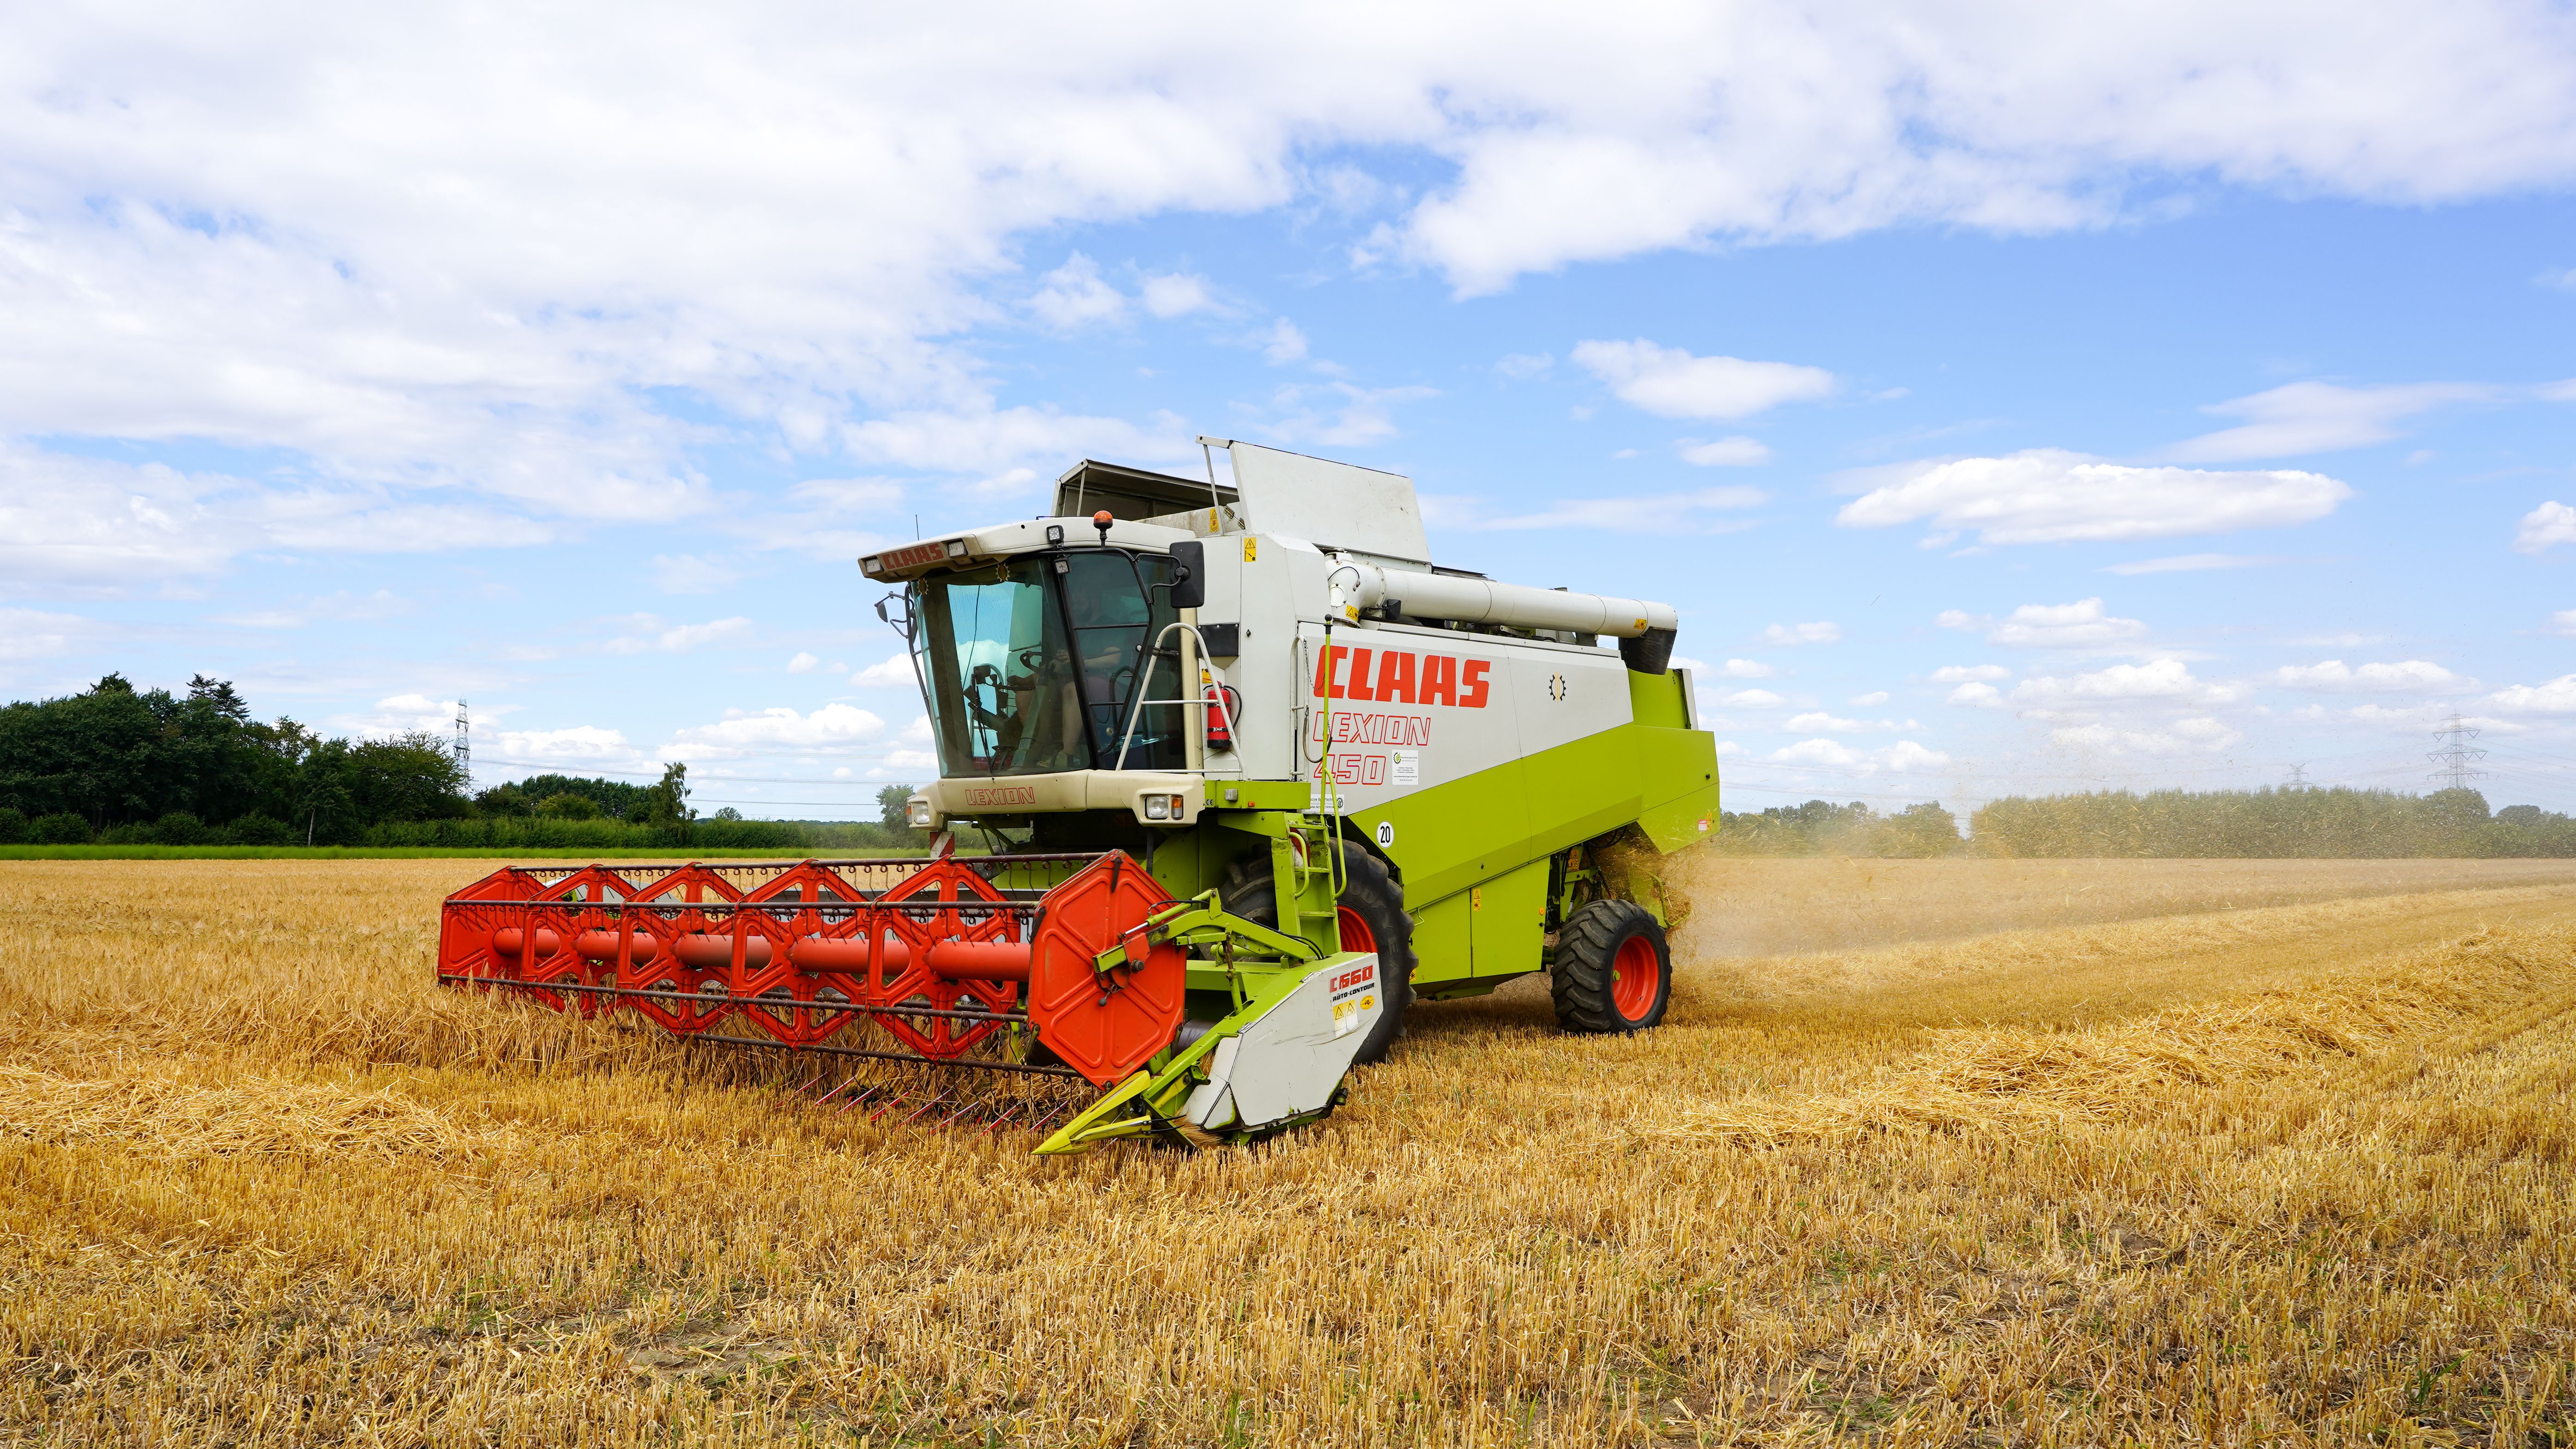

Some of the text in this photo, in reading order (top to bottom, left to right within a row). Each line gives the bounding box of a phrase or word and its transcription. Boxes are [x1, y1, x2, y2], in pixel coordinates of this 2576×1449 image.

[882, 543, 944, 570] CLAAS
[1313, 644, 1490, 709] CLAAS
[1313, 711, 1431, 746] LEXION
[1313, 754, 1386, 785] 450
[965, 787, 1035, 806] LEXION
[1380, 825, 1391, 843] 20
